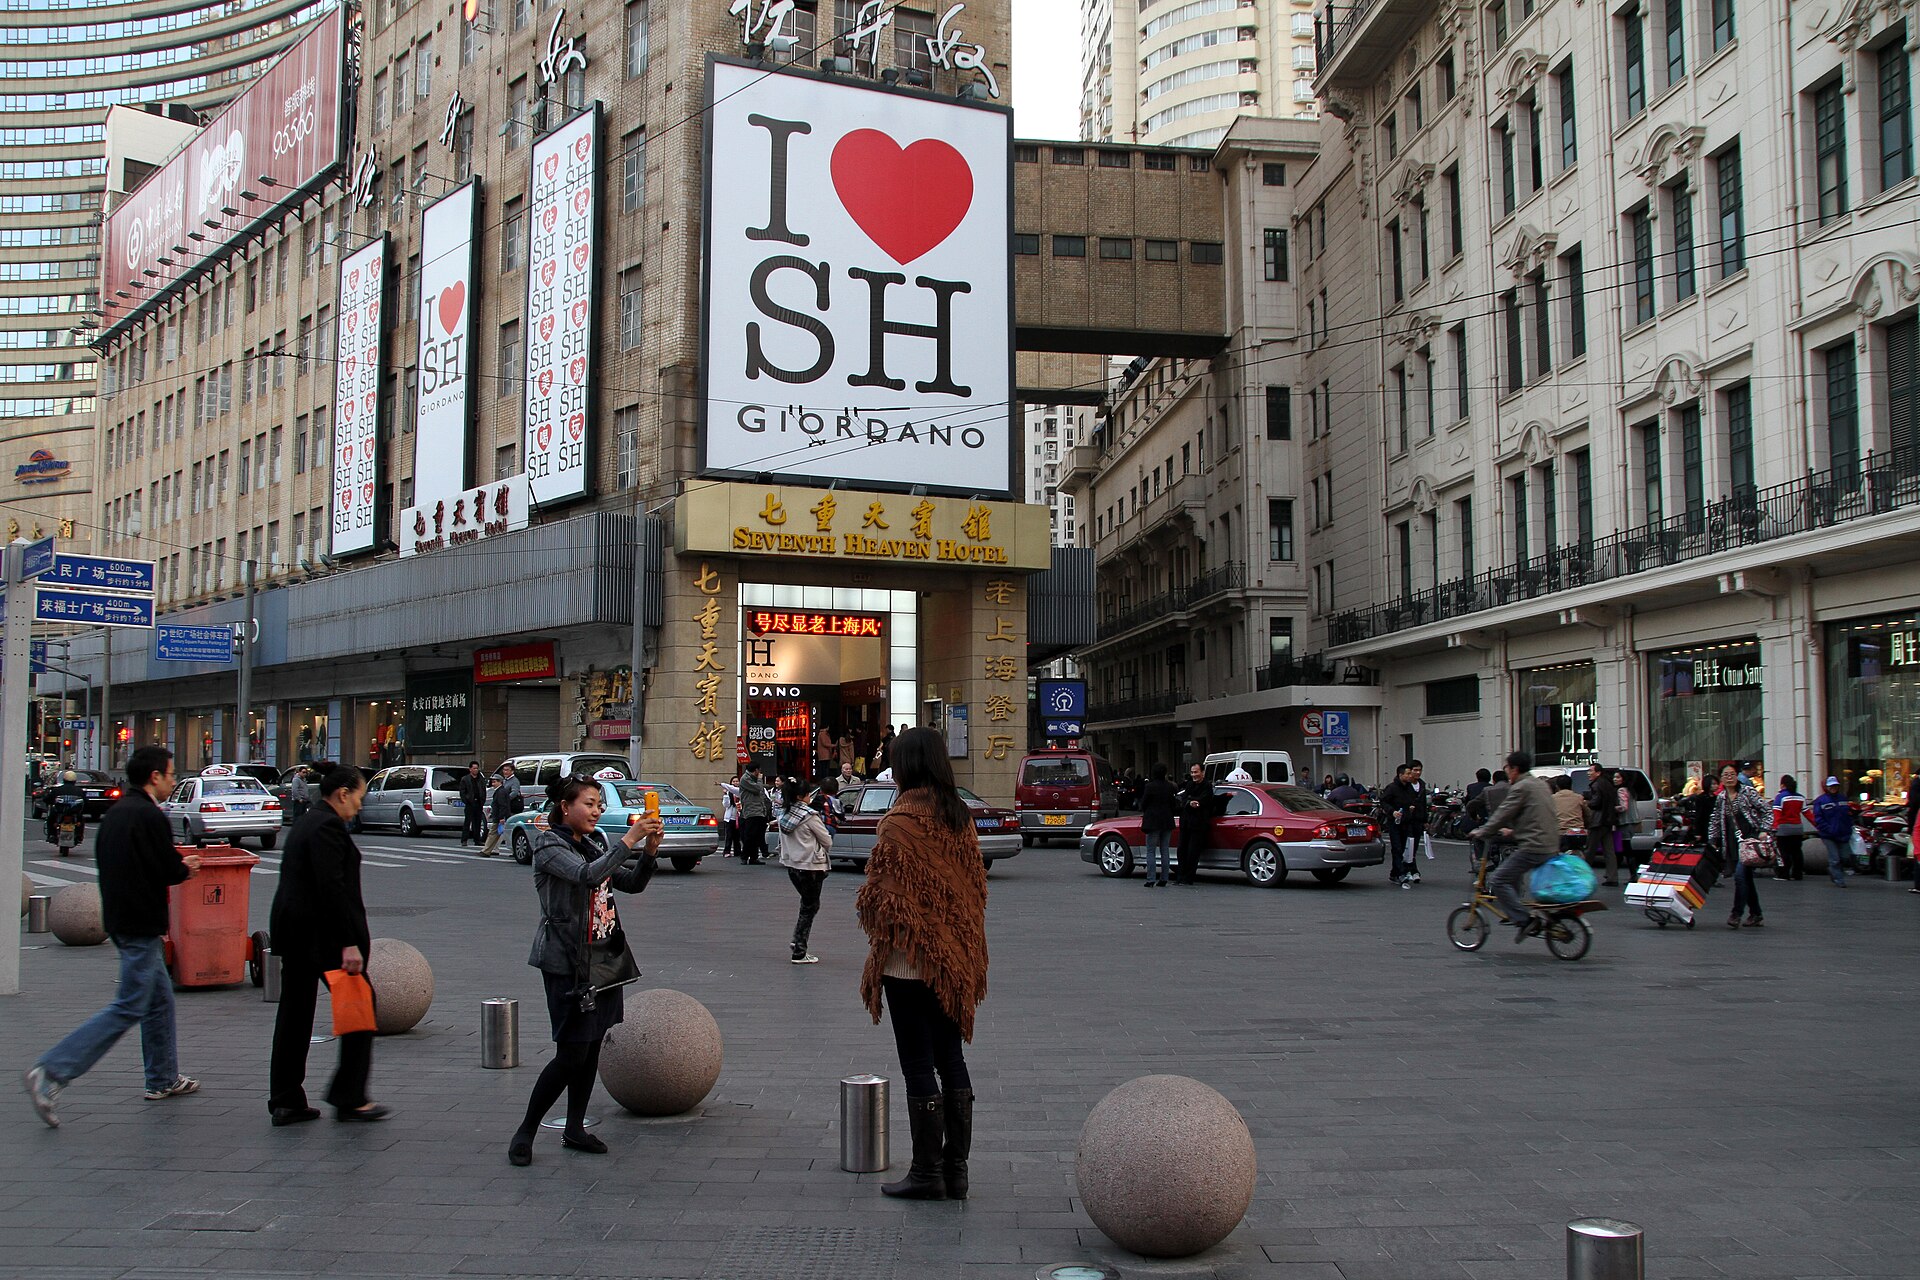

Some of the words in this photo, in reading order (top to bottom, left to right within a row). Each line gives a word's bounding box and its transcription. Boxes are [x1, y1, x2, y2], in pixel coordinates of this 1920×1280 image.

[274, 105, 314, 160] 95566
[566, 142, 574, 170] I
[536, 162, 543, 189] I
[565, 160, 590, 197] SH
[745, 113, 812, 247] I
[535, 179, 557, 214] SH
[565, 196, 573, 224] I
[534, 214, 542, 241] I
[564, 214, 589, 251] SH
[533, 232, 556, 267] SH
[364, 262, 370, 284] I
[564, 251, 572, 279] I
[343, 274, 349, 295] I
[363, 279, 380, 305] SH
[533, 267, 540, 294] I
[562, 270, 588, 305] SH
[342, 291, 358, 315] SH
[532, 286, 555, 320] SH
[342, 316, 347, 338] I
[363, 306, 368, 328] I
[424, 294, 436, 347] I
[562, 306, 570, 334] I
[745, 254, 972, 398] SH
[340, 334, 356, 358] SH
[361, 323, 378, 349] SH
[531, 321, 538, 348] I
[561, 328, 586, 361] SH
[340, 360, 345, 382] I
[361, 351, 367, 372] I
[422, 333, 464, 397] SH
[530, 341, 554, 374] SH
[339, 378, 355, 401] SH
[360, 368, 376, 393] SH
[530, 375, 537, 402] I
[561, 363, 569, 390] I
[360, 396, 365, 418] I
[420, 390, 465, 417] GIORDANO
[529, 397, 552, 429] SH
[560, 385, 585, 417] SH
[338, 404, 343, 426] I
[358, 414, 375, 439] SH
[737, 405, 986, 449] GIORDANO
[337, 422, 354, 446] SH
[529, 430, 536, 456] I
[560, 418, 567, 446] I
[337, 448, 342, 469] I
[358, 441, 363, 463] I
[559, 441, 583, 473] SH
[336, 467, 352, 490] SH
[357, 459, 373, 485] SH
[528, 451, 551, 482] SH
[336, 493, 341, 513] I
[357, 486, 362, 507] I
[335, 511, 351, 534] SH
[356, 505, 372, 529] SH
[733, 526, 836, 553] SEVENTH
[844, 533, 931, 559] HEAVEN
[937, 539, 1008, 563] HOTEL
[110, 563, 132, 572] 600m
[41, 599, 105, 616] 来福士广场
[107, 600, 130, 608] 400m
[755, 613, 882, 636] 号尽显老上海风
[1890, 631, 1920, 666] 周生
[984, 579, 1018, 761] 老上海餐厅
[1694, 658, 1720, 688] 周生生
[749, 686, 800, 697] DANO
[425, 713, 451, 733] 调整中
[609, 724, 631, 735] RESTAURA
[1326, 713, 1340, 735] P
